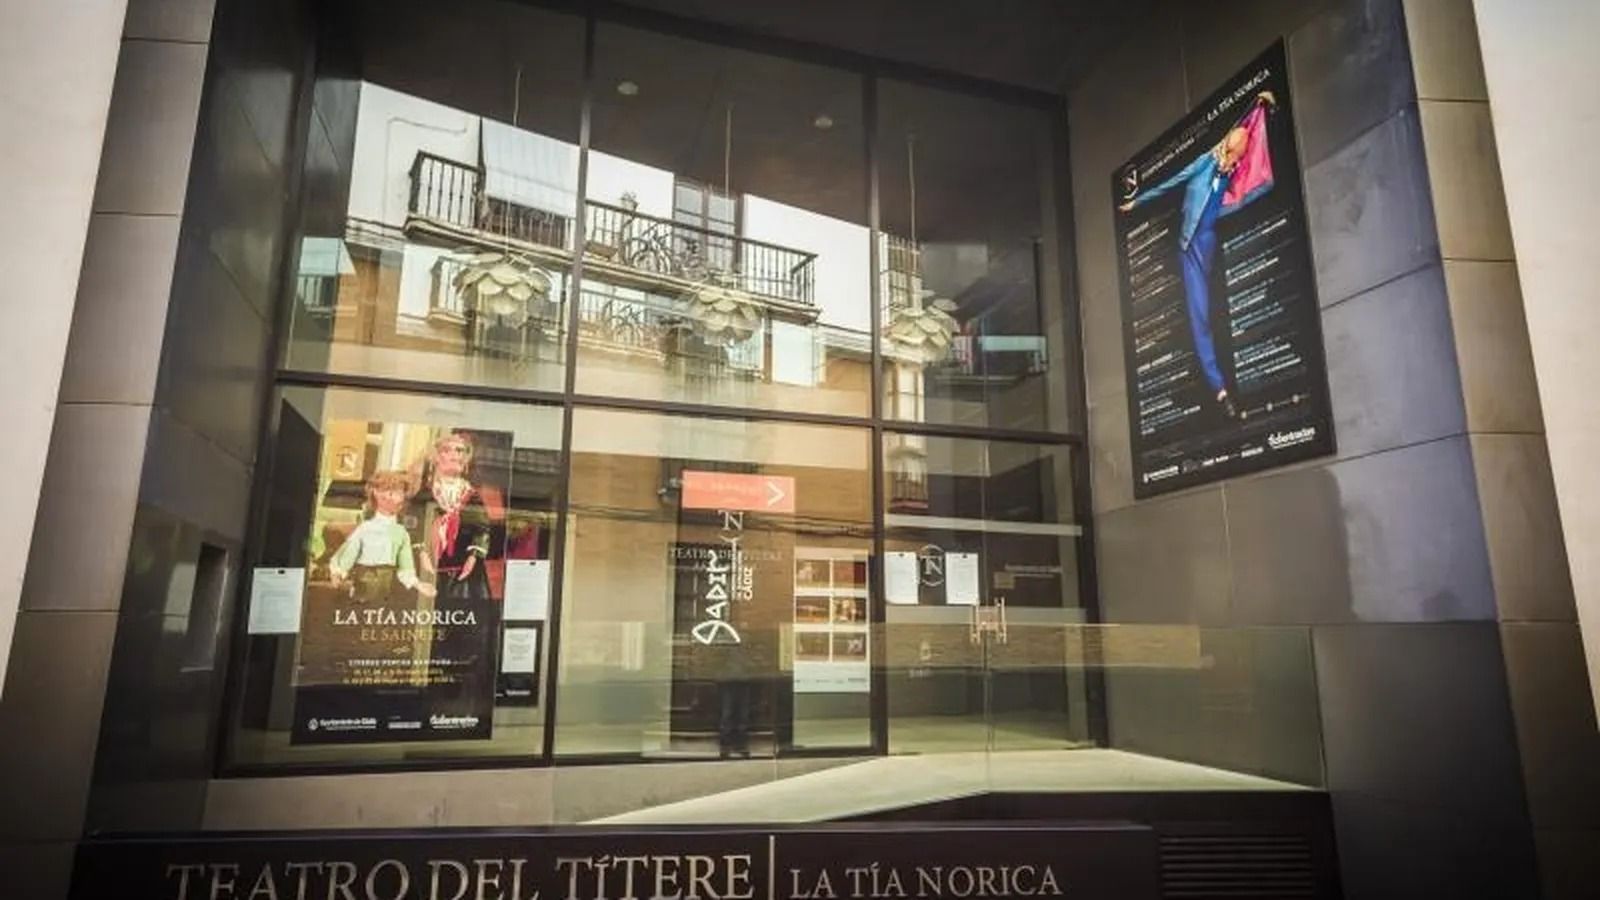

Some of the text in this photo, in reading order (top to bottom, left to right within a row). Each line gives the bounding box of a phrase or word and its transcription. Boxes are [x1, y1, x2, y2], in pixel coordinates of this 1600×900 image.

[333, 606, 477, 625] LA TÍA NORICA
[360, 628, 377, 641] EL
[165, 854, 1063, 900] TEATRO DEL TÍTERE LA TÍA NORICA
